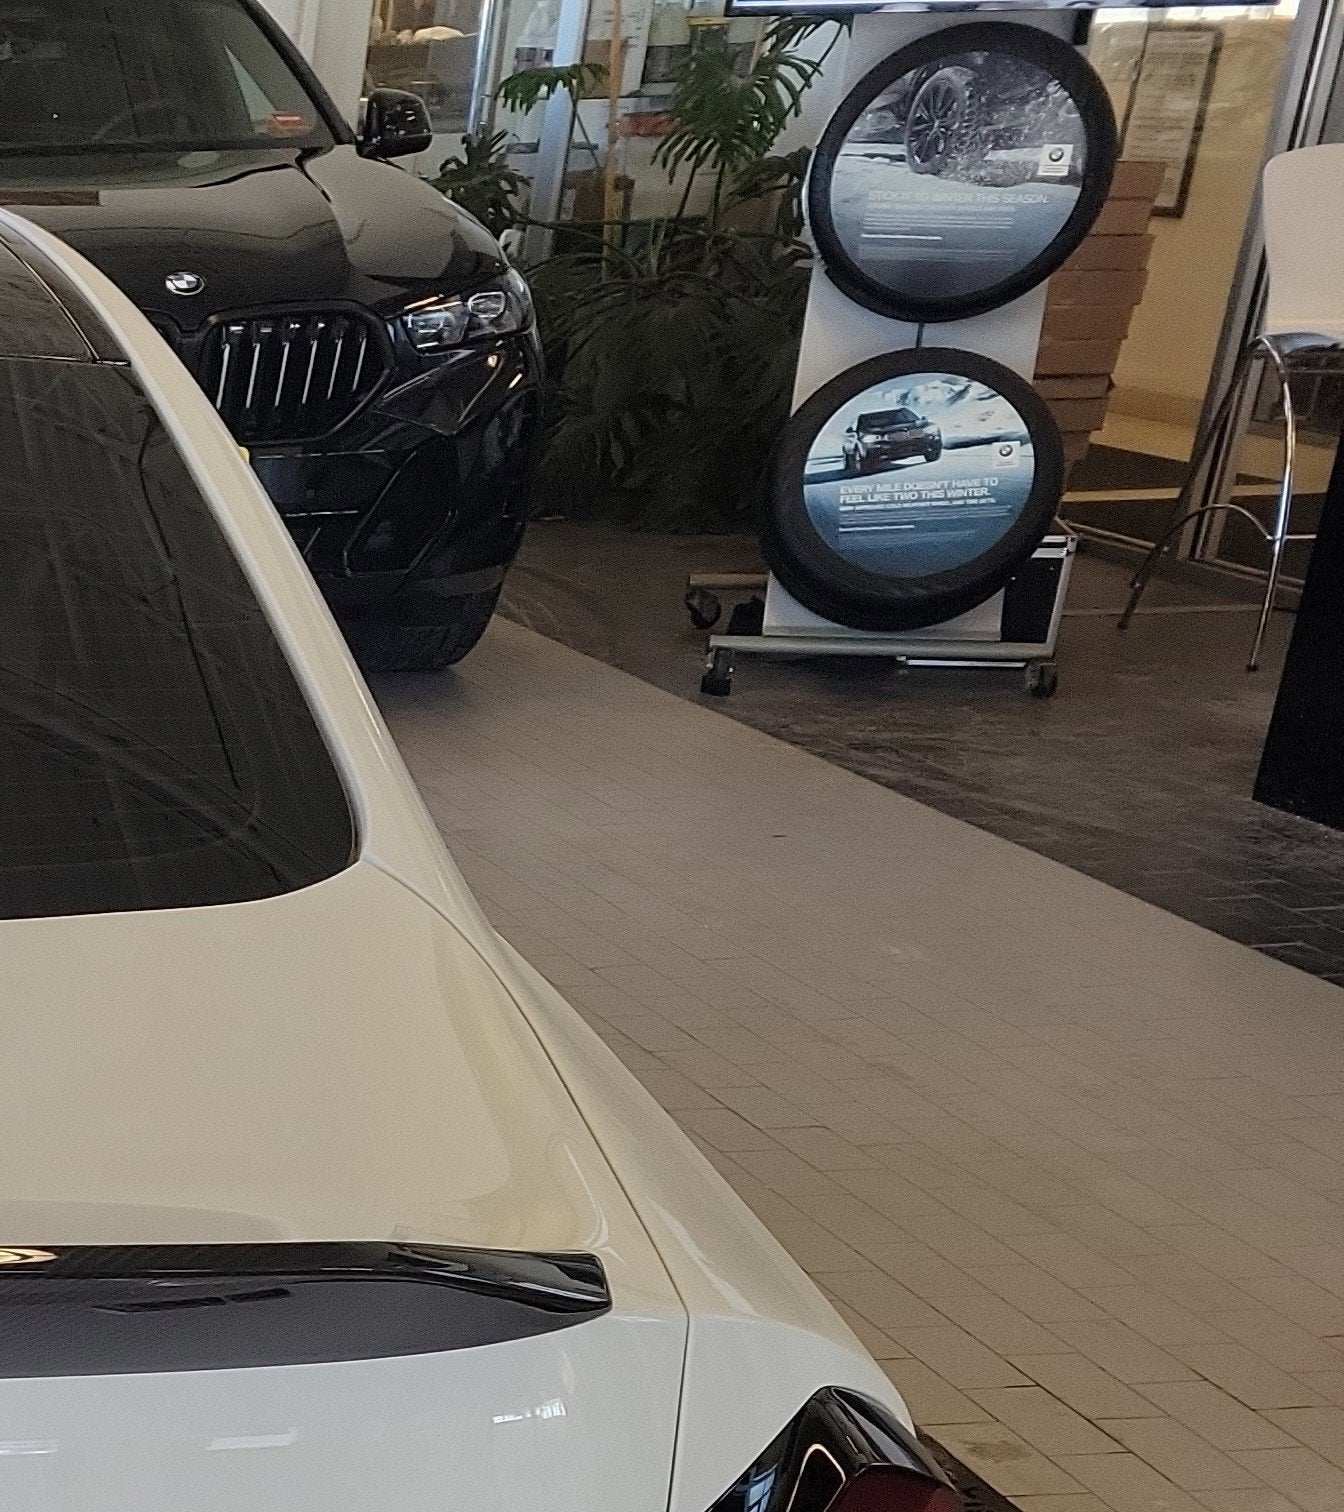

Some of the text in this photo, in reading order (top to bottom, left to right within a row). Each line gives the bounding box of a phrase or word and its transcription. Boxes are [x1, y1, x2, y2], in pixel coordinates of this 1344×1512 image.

[840, 484, 875, 494] EVERY
[877, 483, 902, 493] MILE
[952, 478, 982, 488] HAVE
[984, 477, 999, 486] TO
[840, 494, 865, 504] FEEL
[867, 493, 891, 502] LIKE
[894, 491, 919, 501] TWO
[921, 489, 945, 499] THIS
